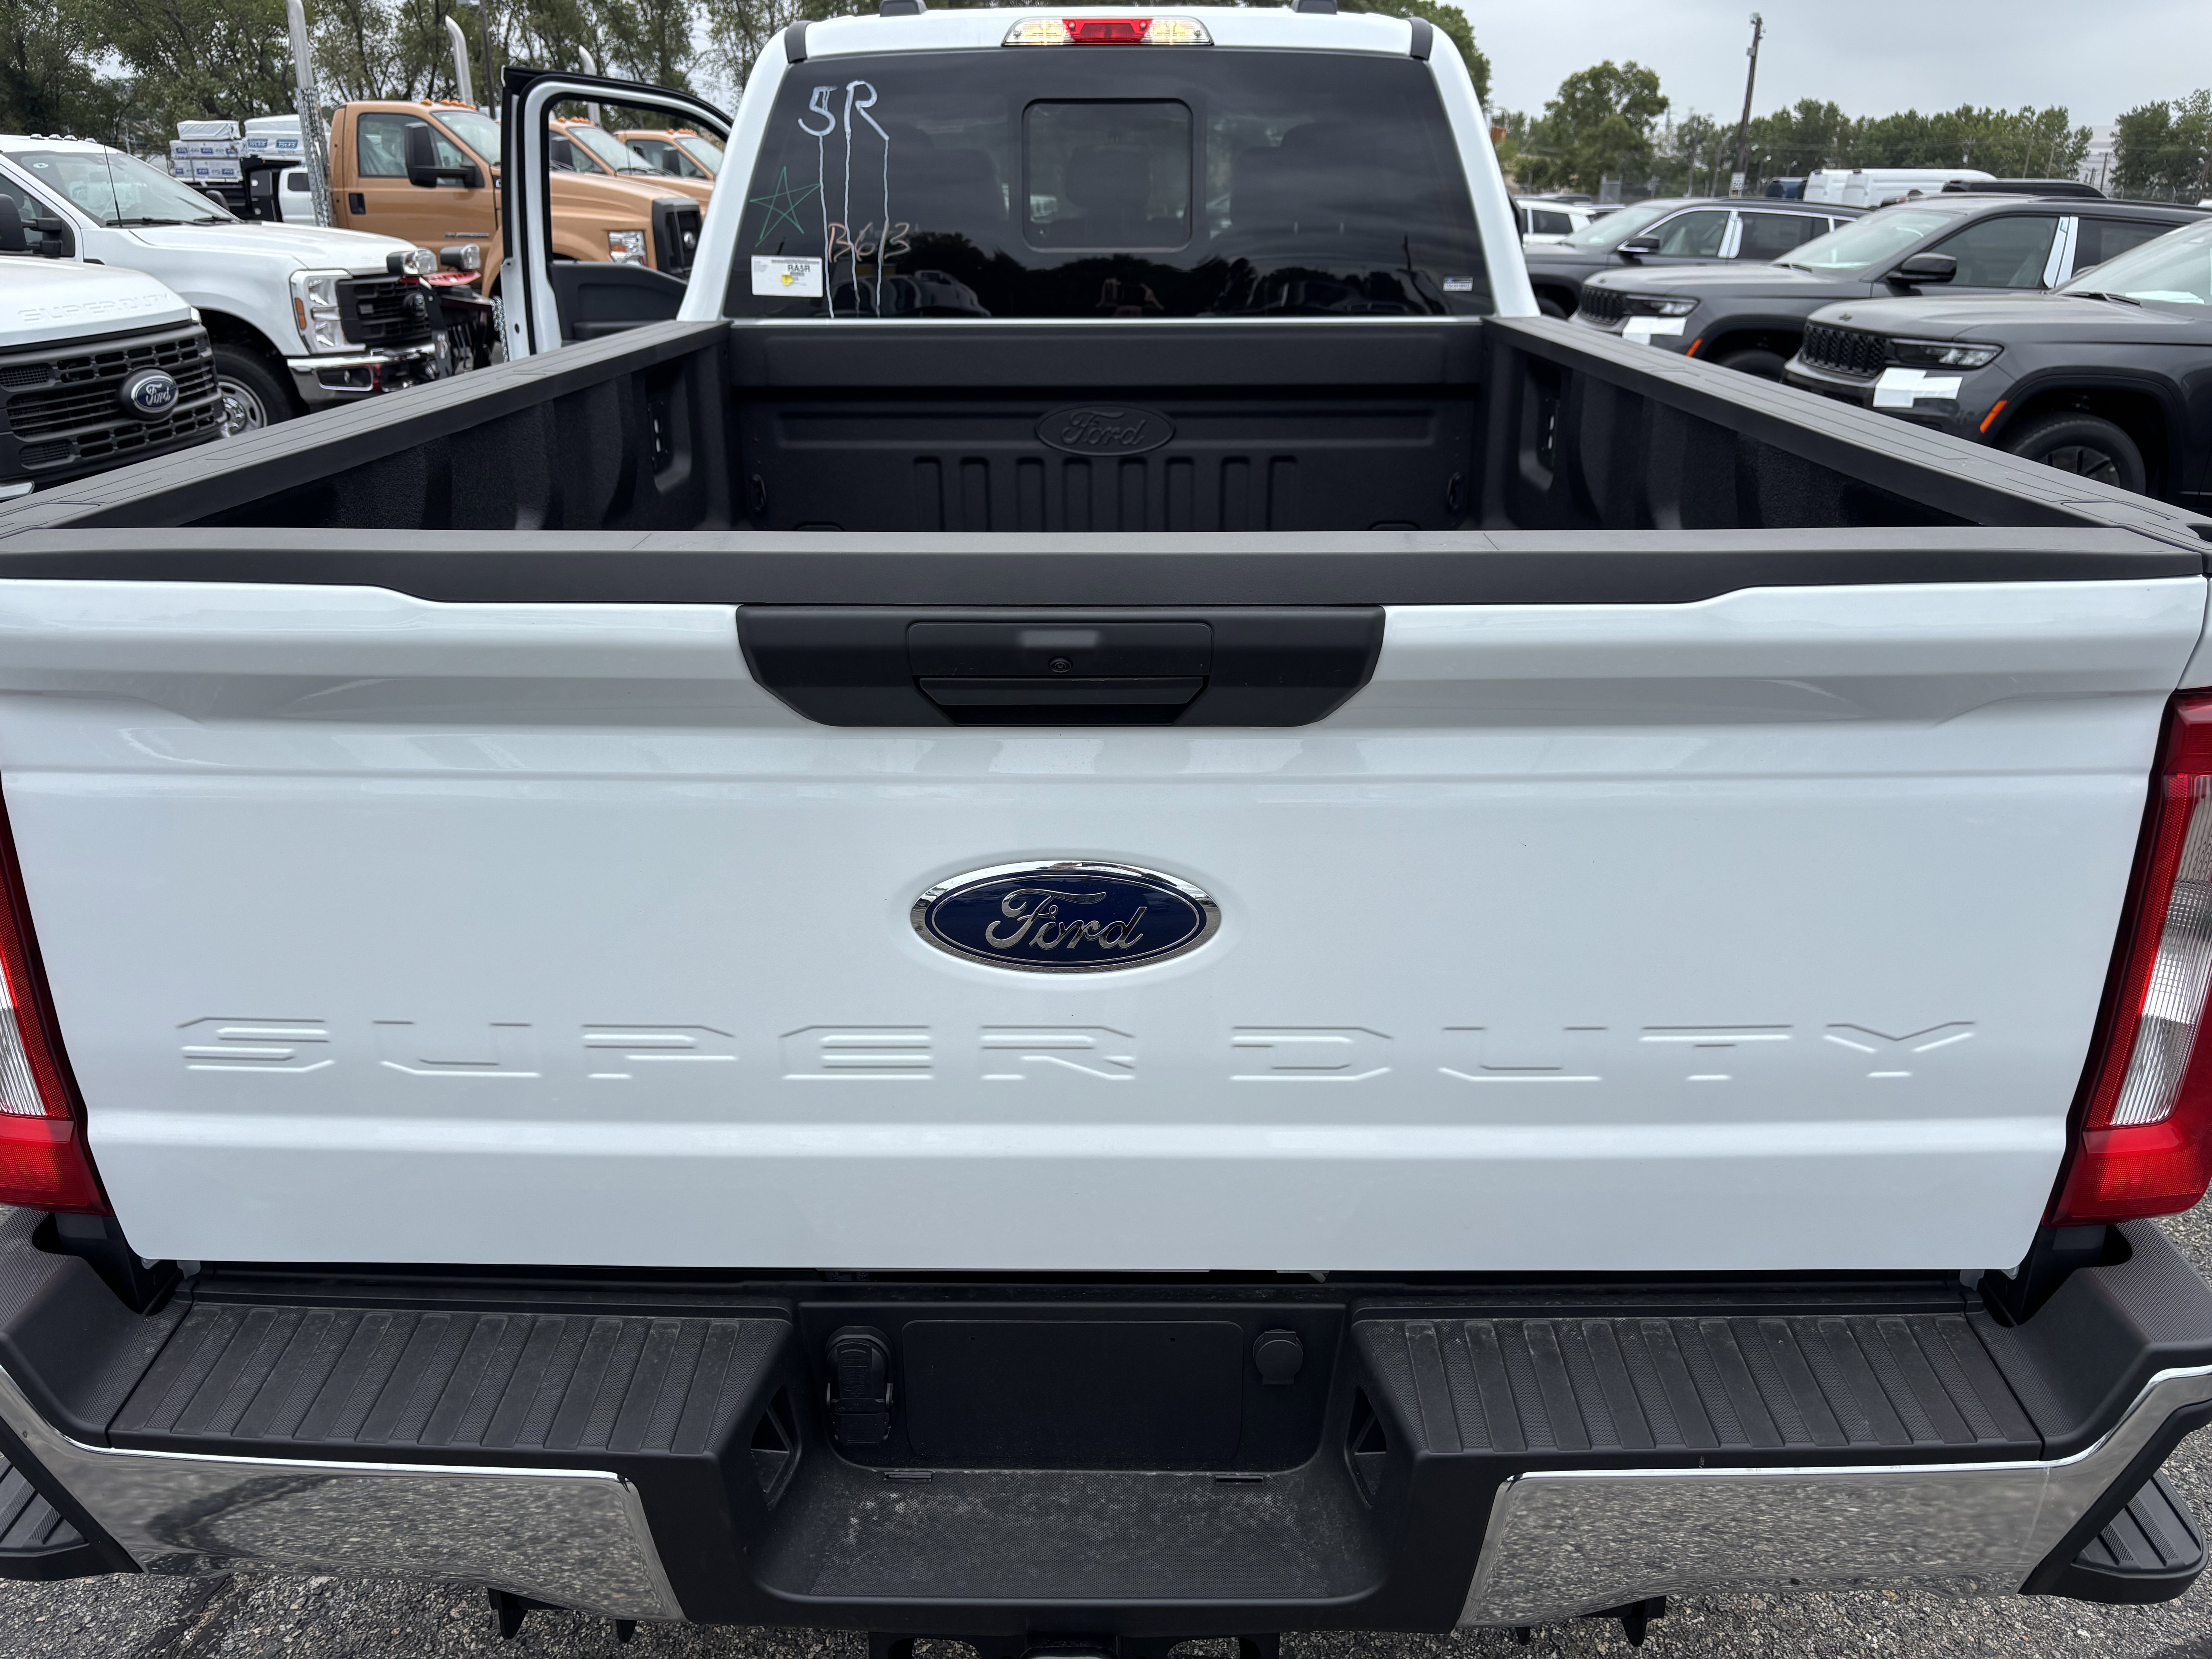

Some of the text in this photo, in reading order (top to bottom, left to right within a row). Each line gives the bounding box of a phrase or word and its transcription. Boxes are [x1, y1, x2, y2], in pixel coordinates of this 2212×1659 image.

[18, 301, 116, 323] SUPER
[146, 383, 171, 406] Ford
[1061, 410, 1146, 445] Ford
[985, 888, 1147, 950] Ford
[175, 1016, 1977, 1082] SUPER DUTY
